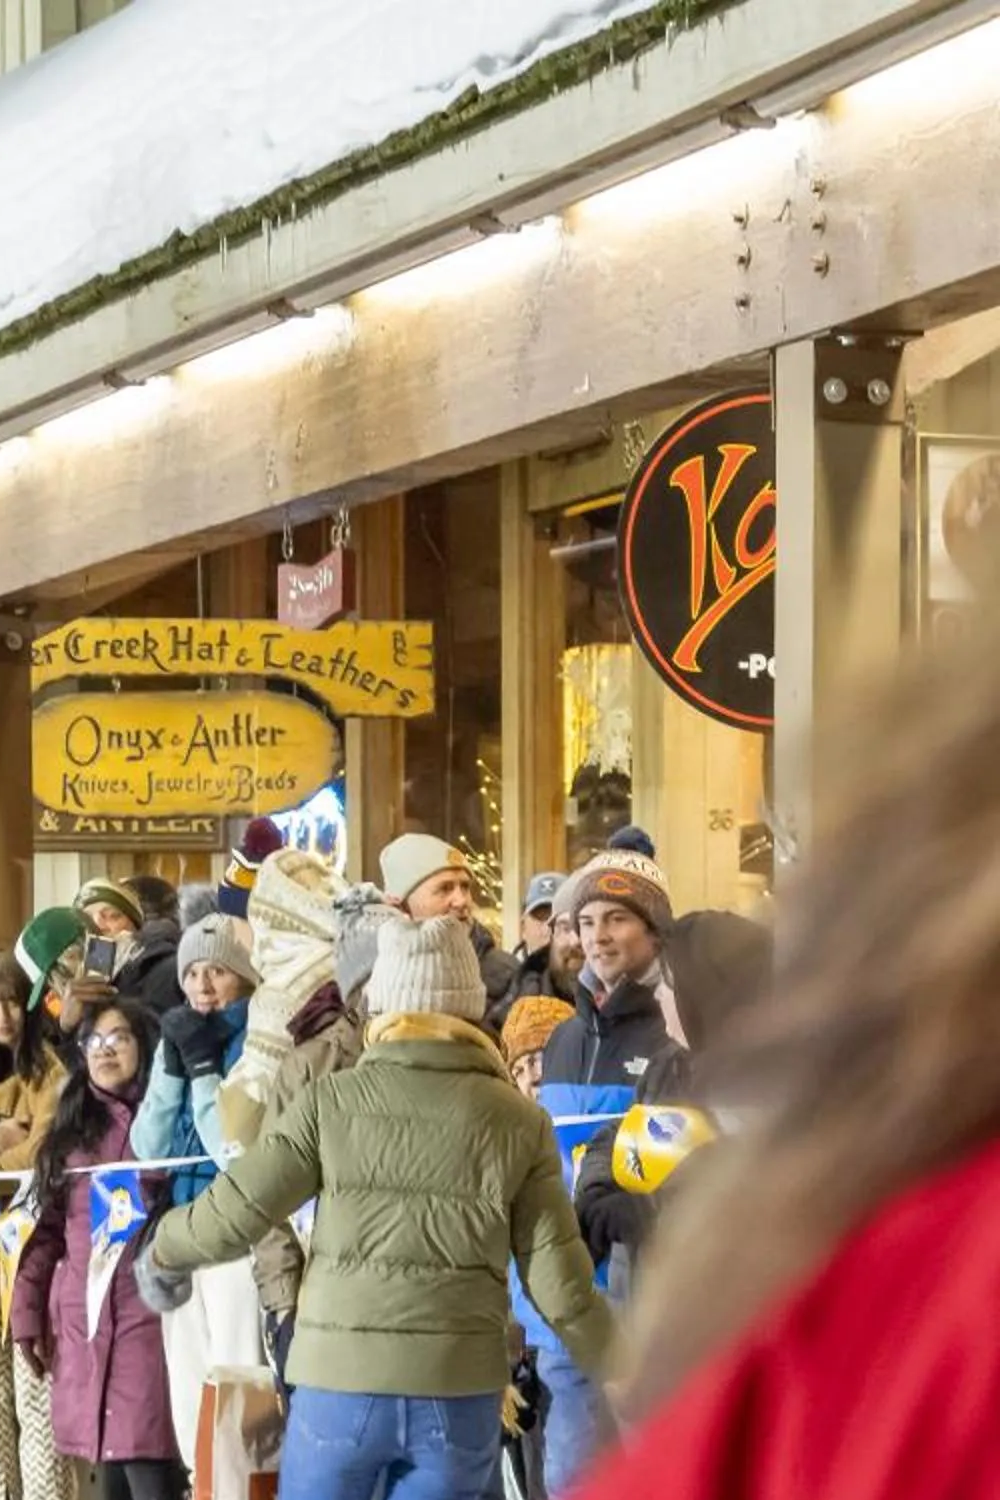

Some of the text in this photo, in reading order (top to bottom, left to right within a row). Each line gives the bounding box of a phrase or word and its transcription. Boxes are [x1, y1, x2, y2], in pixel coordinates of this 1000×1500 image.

[63, 628, 171, 673] Creek
[168, 625, 230, 664] Hat
[235, 648, 253, 667] &
[260, 633, 416, 708] Leathers
[65, 714, 165, 766] Onyx
[181, 713, 287, 765] Antler
[227, 765, 299, 804] Beads
